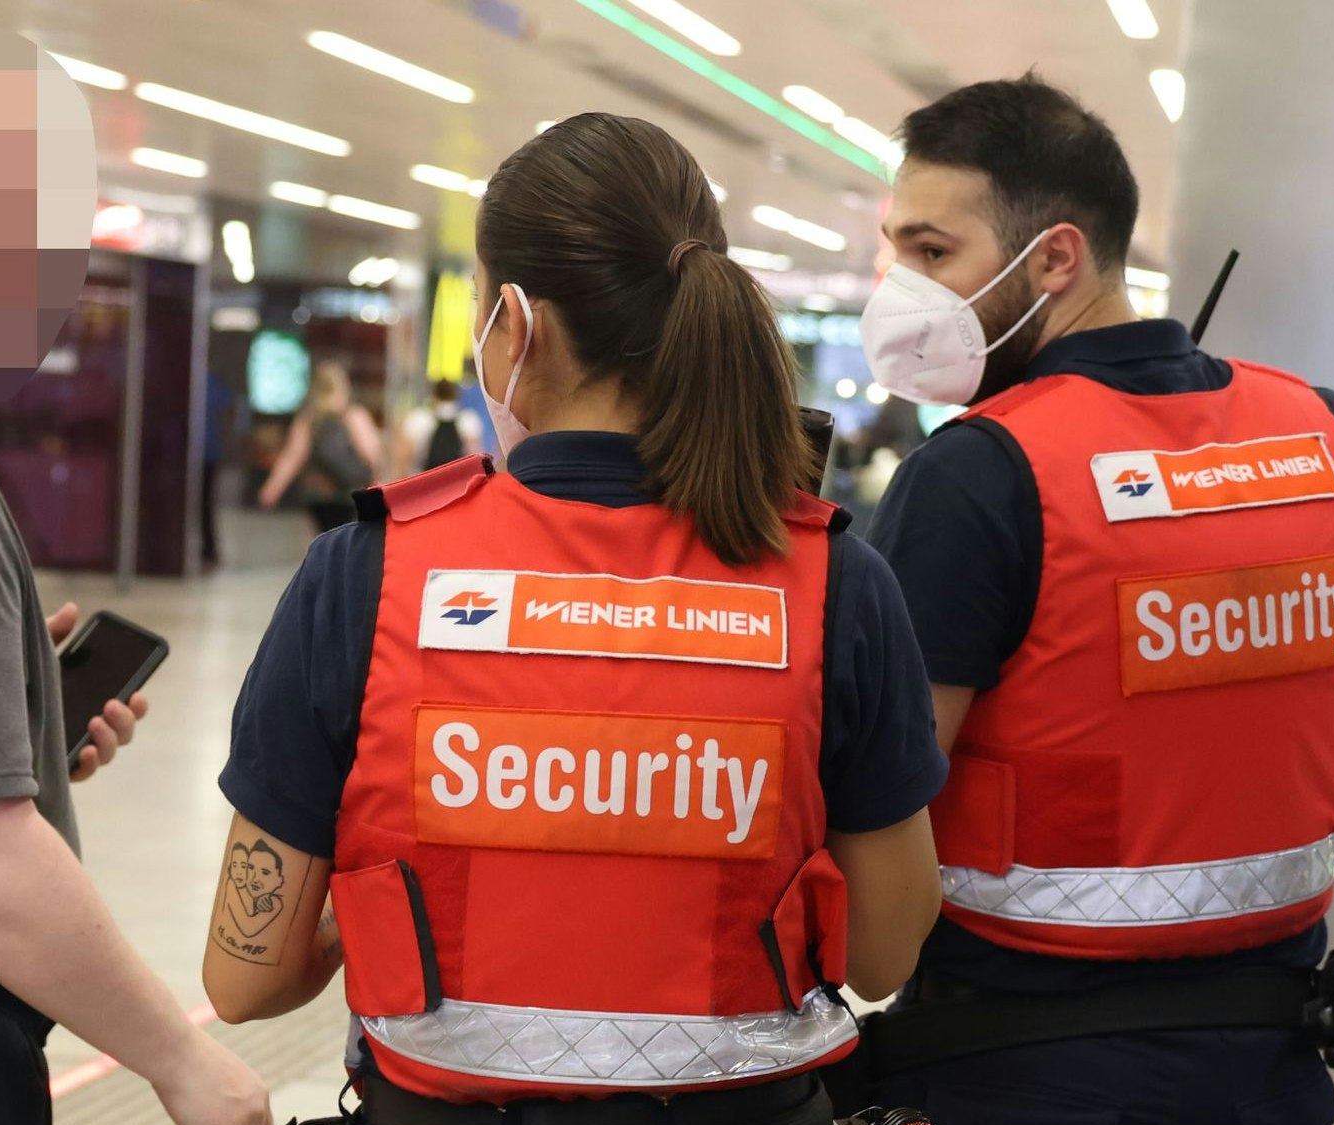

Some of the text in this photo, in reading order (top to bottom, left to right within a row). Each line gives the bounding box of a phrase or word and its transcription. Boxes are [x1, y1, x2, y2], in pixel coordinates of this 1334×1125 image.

[1171, 454, 1325, 489] WIENER LINIEN
[524, 598, 771, 637] WIENER LINIEN
[430, 721, 768, 844] Security
